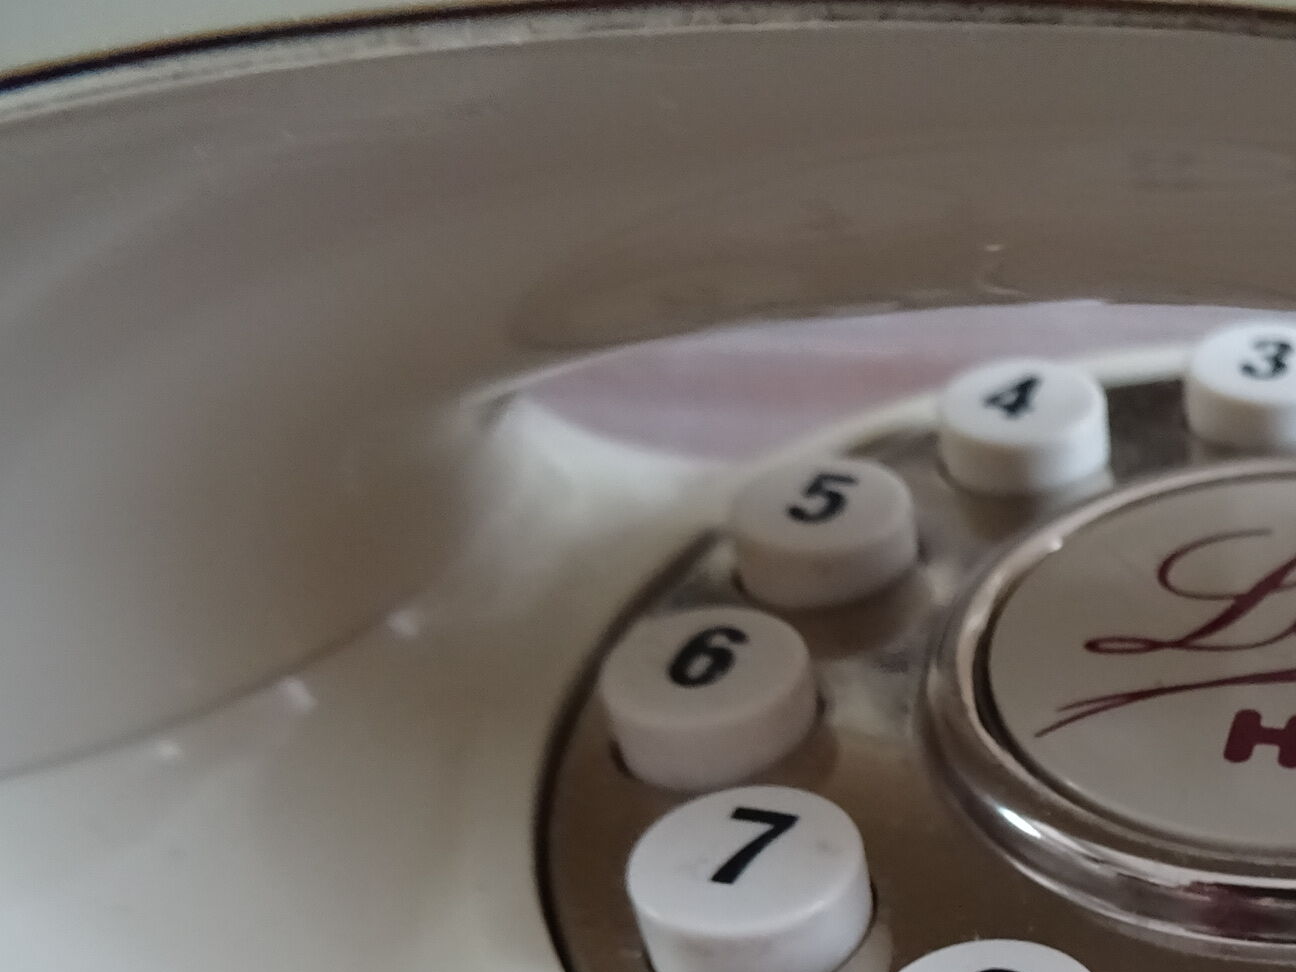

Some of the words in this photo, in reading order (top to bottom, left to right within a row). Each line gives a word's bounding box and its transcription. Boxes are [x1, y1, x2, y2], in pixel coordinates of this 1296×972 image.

[1239, 339, 1295, 382] 3
[983, 374, 1042, 420] 4
[785, 472, 858, 526] 5
[665, 625, 749, 690] 6
[710, 806, 800, 885] 7
